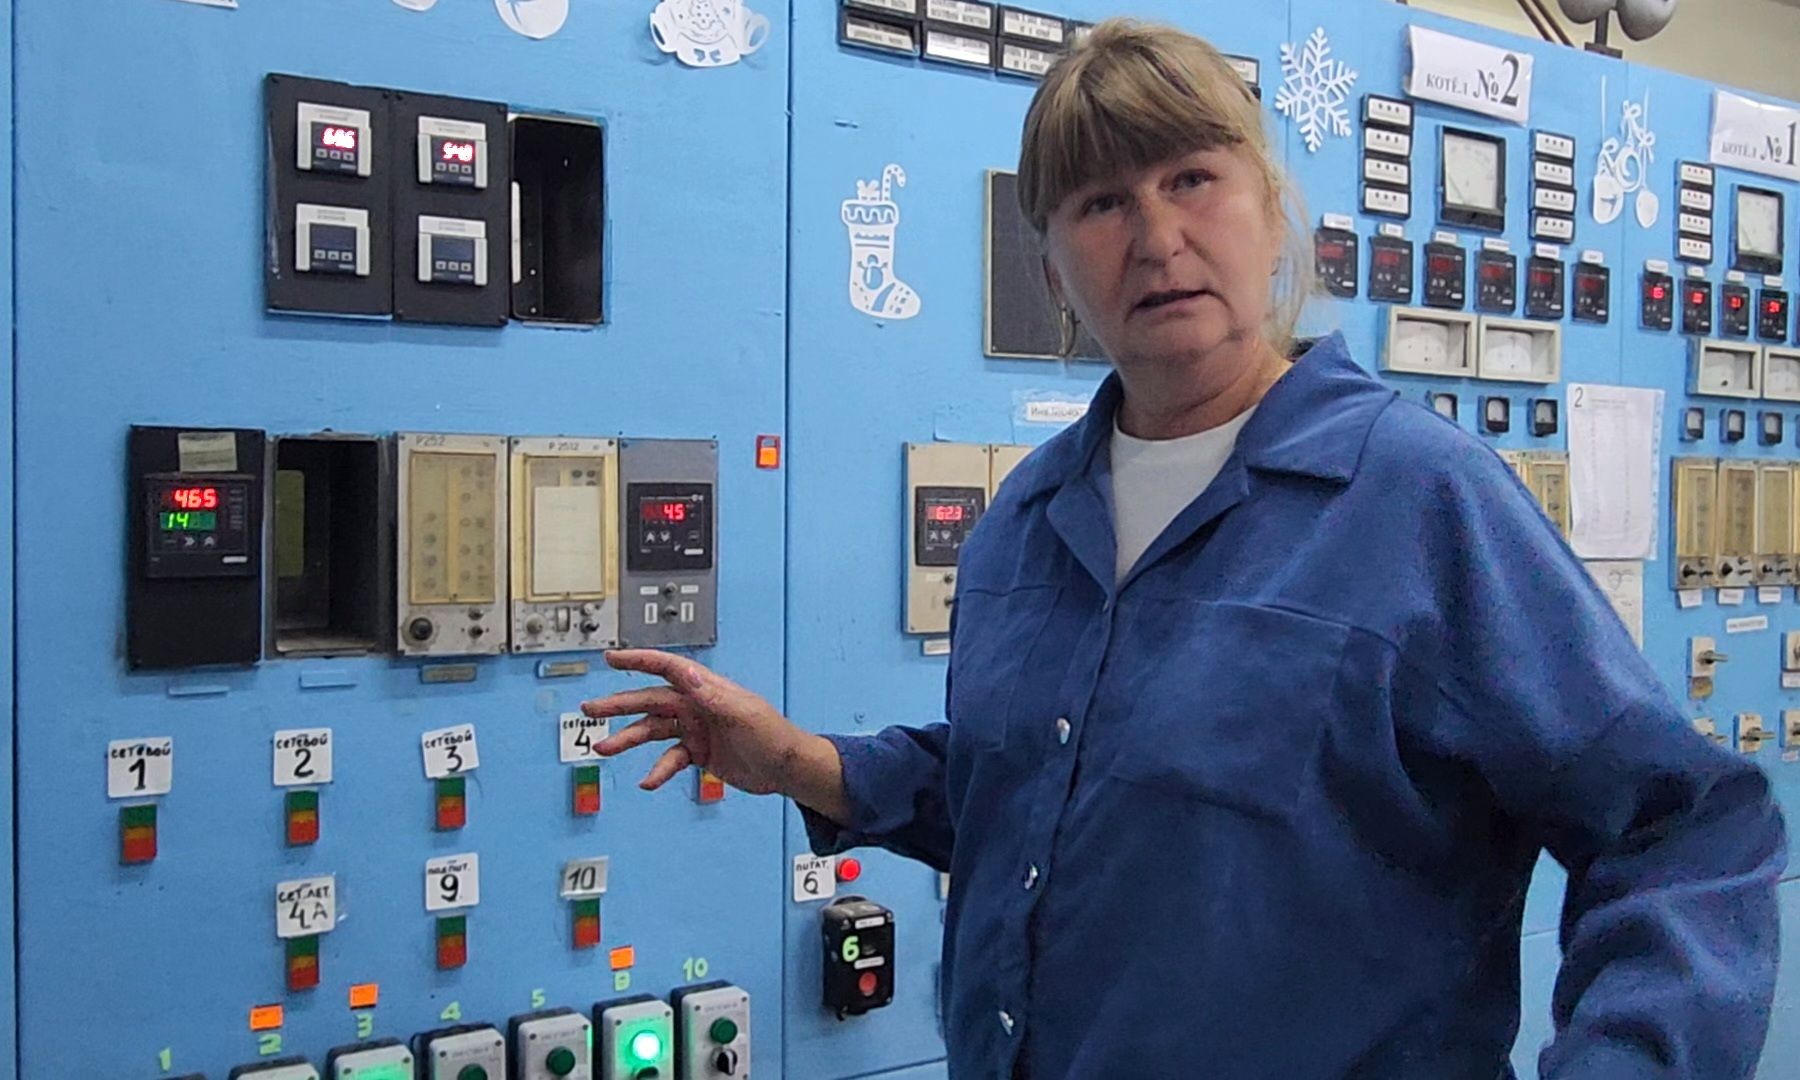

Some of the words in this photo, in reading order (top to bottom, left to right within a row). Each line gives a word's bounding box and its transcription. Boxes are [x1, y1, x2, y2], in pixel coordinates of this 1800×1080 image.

[1425, 73, 1468, 96] КОТЁЛ
[574, 727, 591, 756] 4
[294, 747, 314, 778] 2
[444, 745, 463, 772] 3
[128, 758, 146, 791] 1
[440, 873, 459, 902] 9
[568, 866, 596, 891] 10
[803, 870, 819, 895] 6
[842, 936, 860, 962] 6
[683, 957, 708, 981] 10
[441, 1001, 461, 1020] 4
[532, 988, 545, 1008] 5
[354, 1012, 373, 1039] 3
[257, 1033, 282, 1056] 2
[159, 1047, 172, 1071] 1
